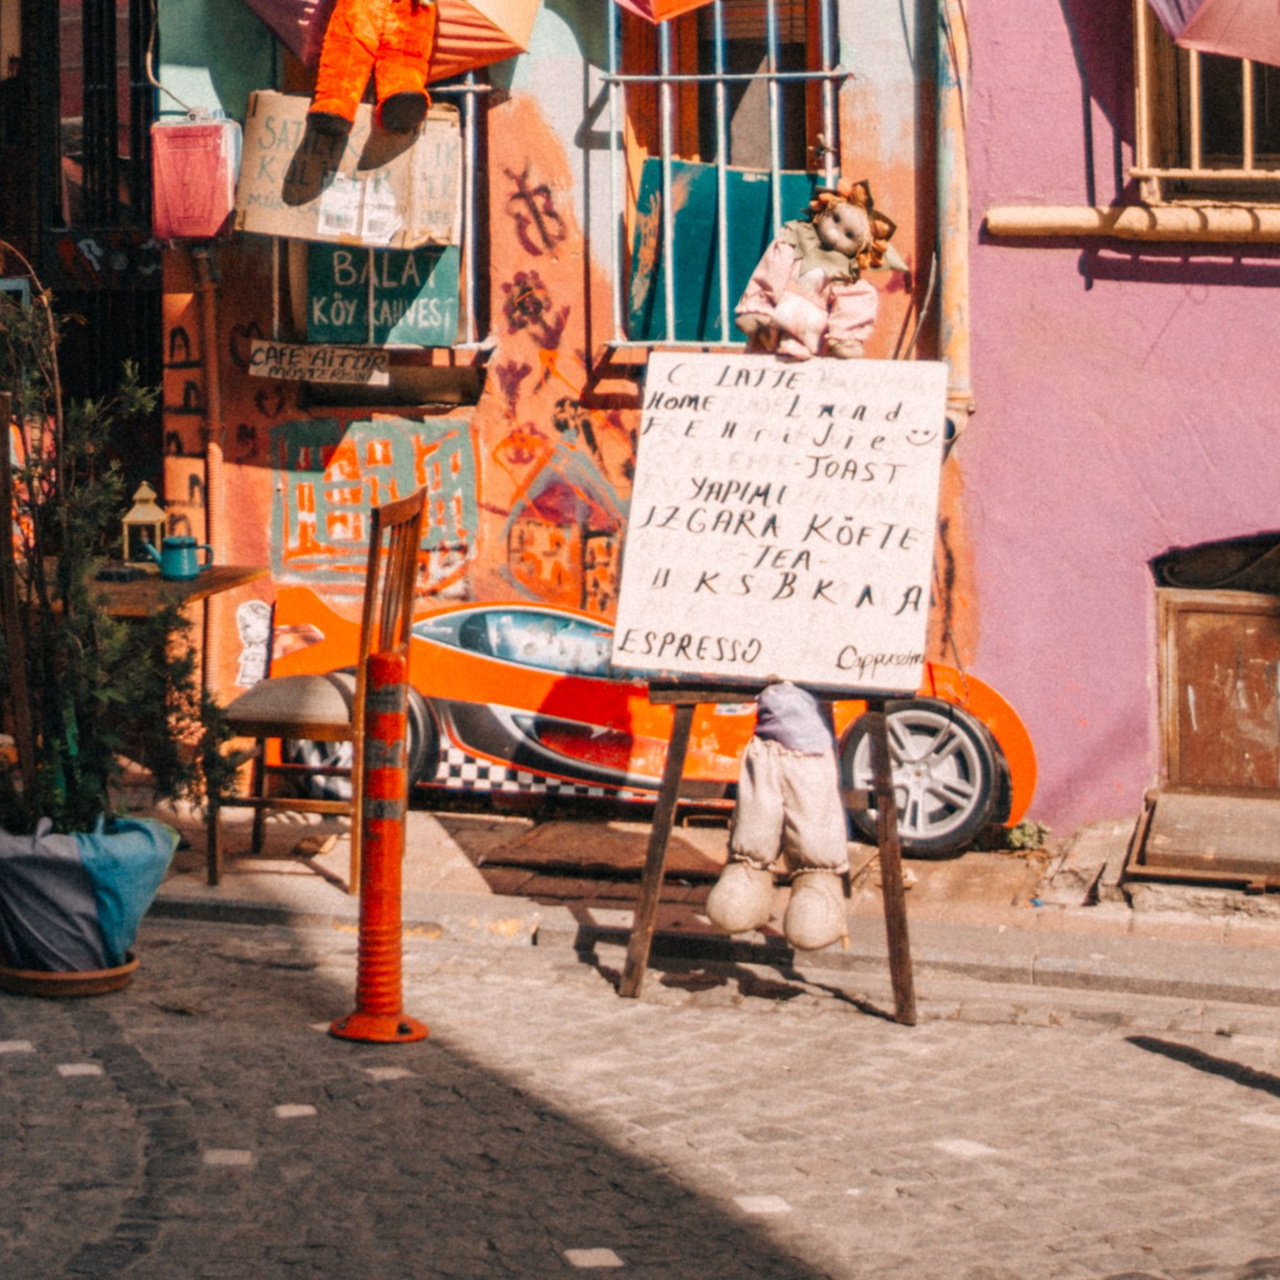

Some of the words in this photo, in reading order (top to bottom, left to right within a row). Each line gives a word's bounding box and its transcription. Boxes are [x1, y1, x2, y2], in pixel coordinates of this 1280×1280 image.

[333, 250, 443, 289] BALAT
[312, 292, 358, 326] KÖY
[251, 346, 304, 365] CAFE
[714, 365, 803, 389] LATTE
[646, 391, 718, 412] HOME
[690, 477, 788, 506] YAPIMI
[802, 514, 924, 551] KÖFTE
[617, 627, 763, 664] ESPRESSO
